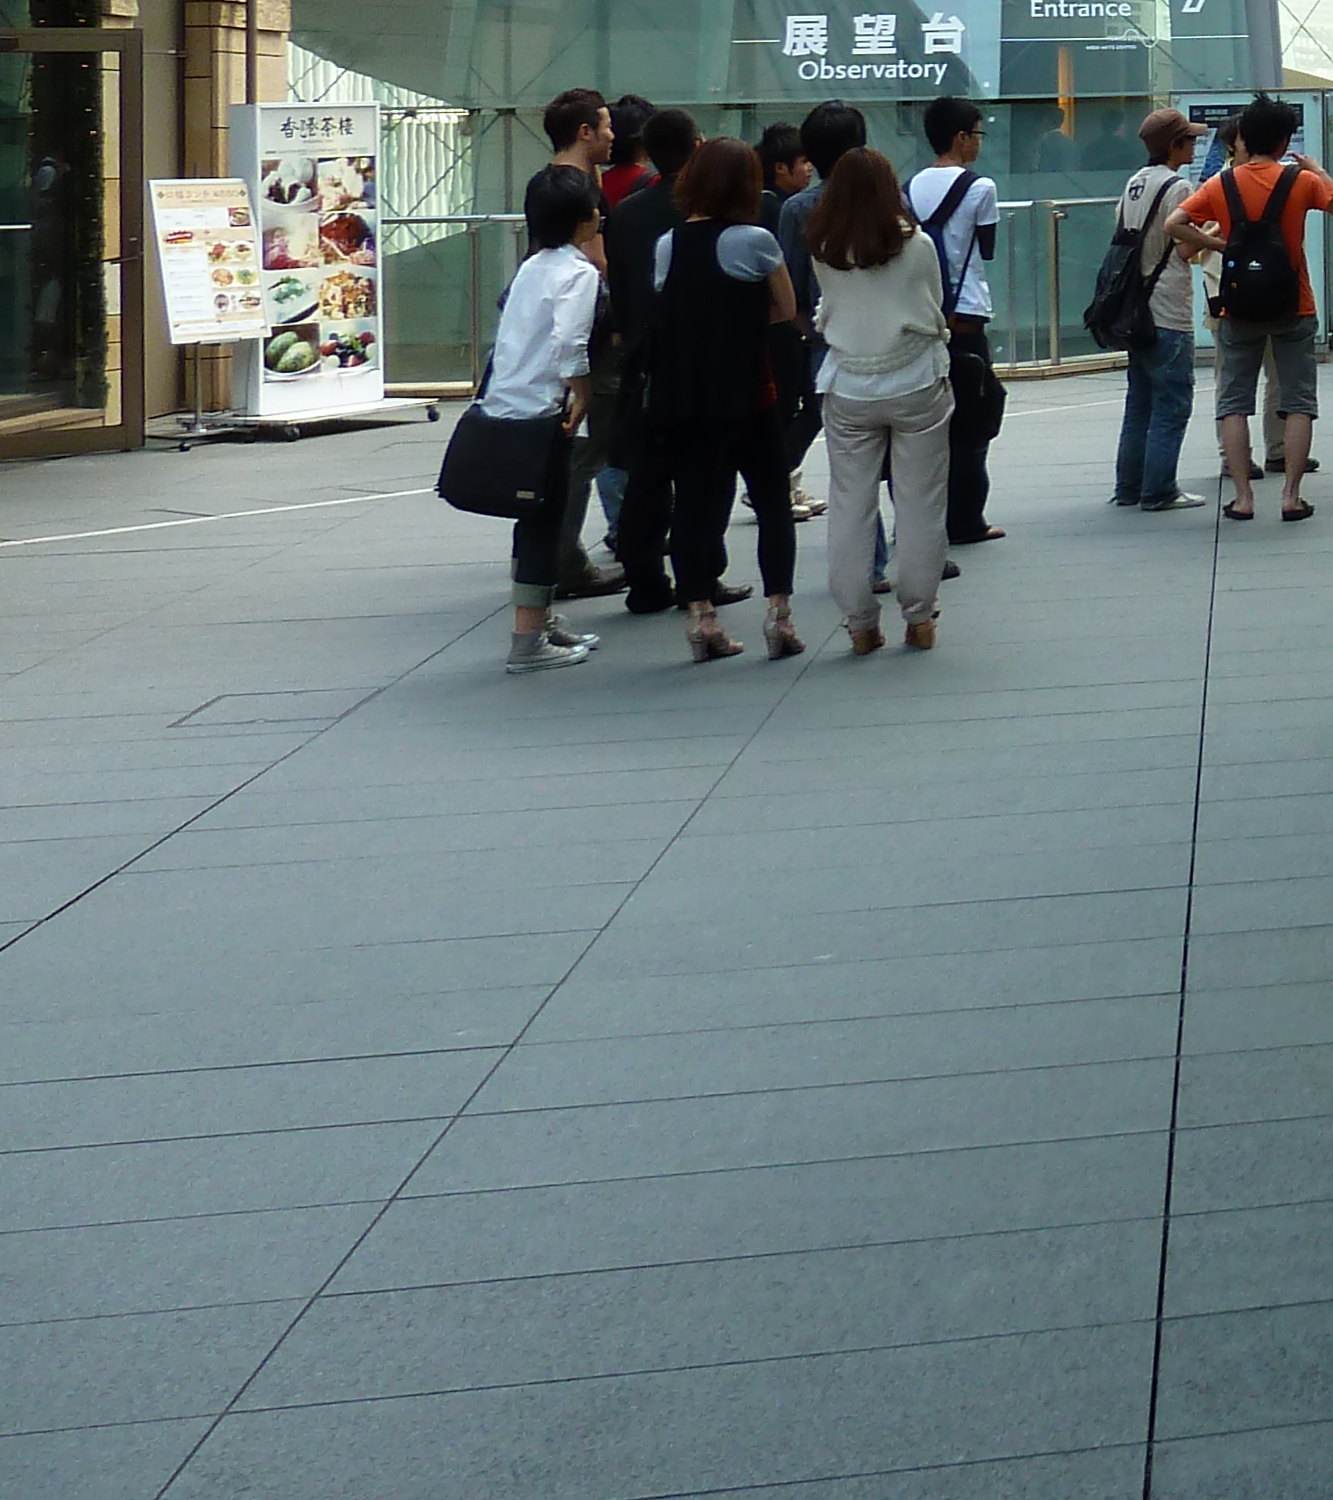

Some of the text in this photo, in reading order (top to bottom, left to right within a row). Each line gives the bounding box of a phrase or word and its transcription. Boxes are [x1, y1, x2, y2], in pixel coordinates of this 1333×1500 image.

[1030, 0, 1132, 18] Entrance
[782, 12, 967, 56] 展望台
[798, 61, 948, 85] Observatory
